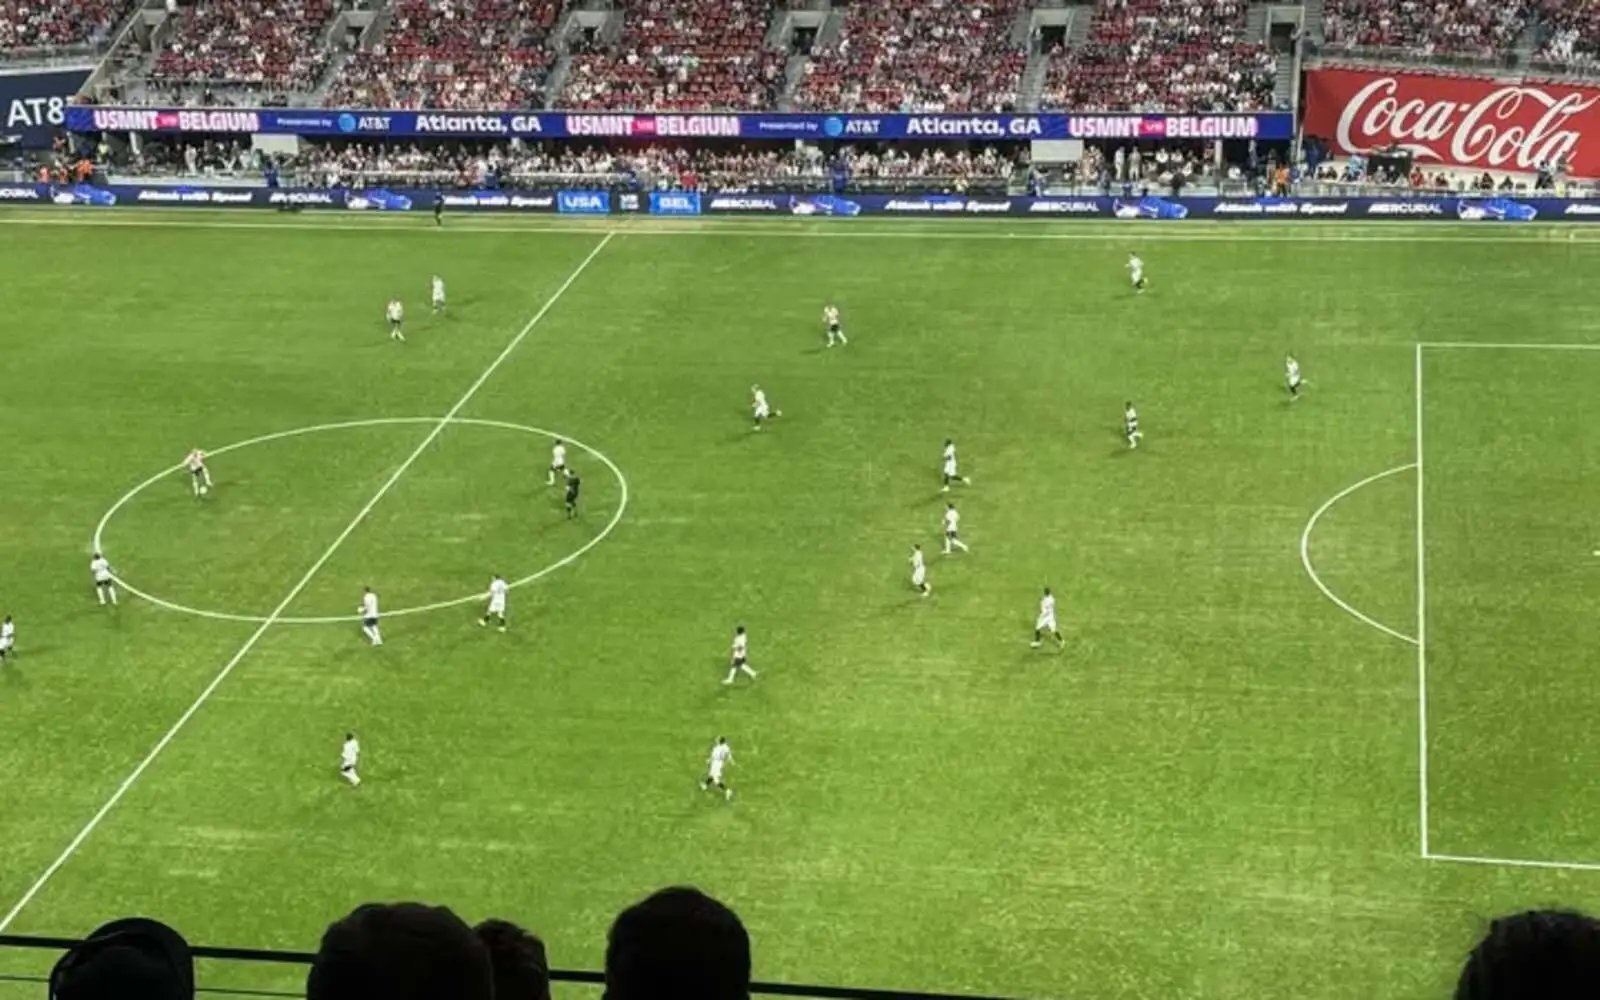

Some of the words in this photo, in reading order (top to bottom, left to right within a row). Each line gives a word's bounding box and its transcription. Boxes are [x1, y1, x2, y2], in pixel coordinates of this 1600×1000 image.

[7, 96, 74, 127] AT&
[93, 109, 158, 130] USMNT
[179, 110, 259, 133] BELGIUM
[358, 116, 391, 130] AT&T
[415, 115, 507, 134] Atlanta,
[511, 116, 541, 132] GA
[566, 115, 633, 135] USMNT
[656, 116, 739, 136] BELGIUM
[845, 119, 880, 133] AT&T
[906, 117, 1005, 137] Atlanta,
[1009, 118, 1041, 135] GA
[1069, 117, 1142, 137] USMNT
[1165, 117, 1257, 137] BELGIUM
[1336, 77, 1600, 172] Coca-Cola
[565, 195, 601, 208] USA
